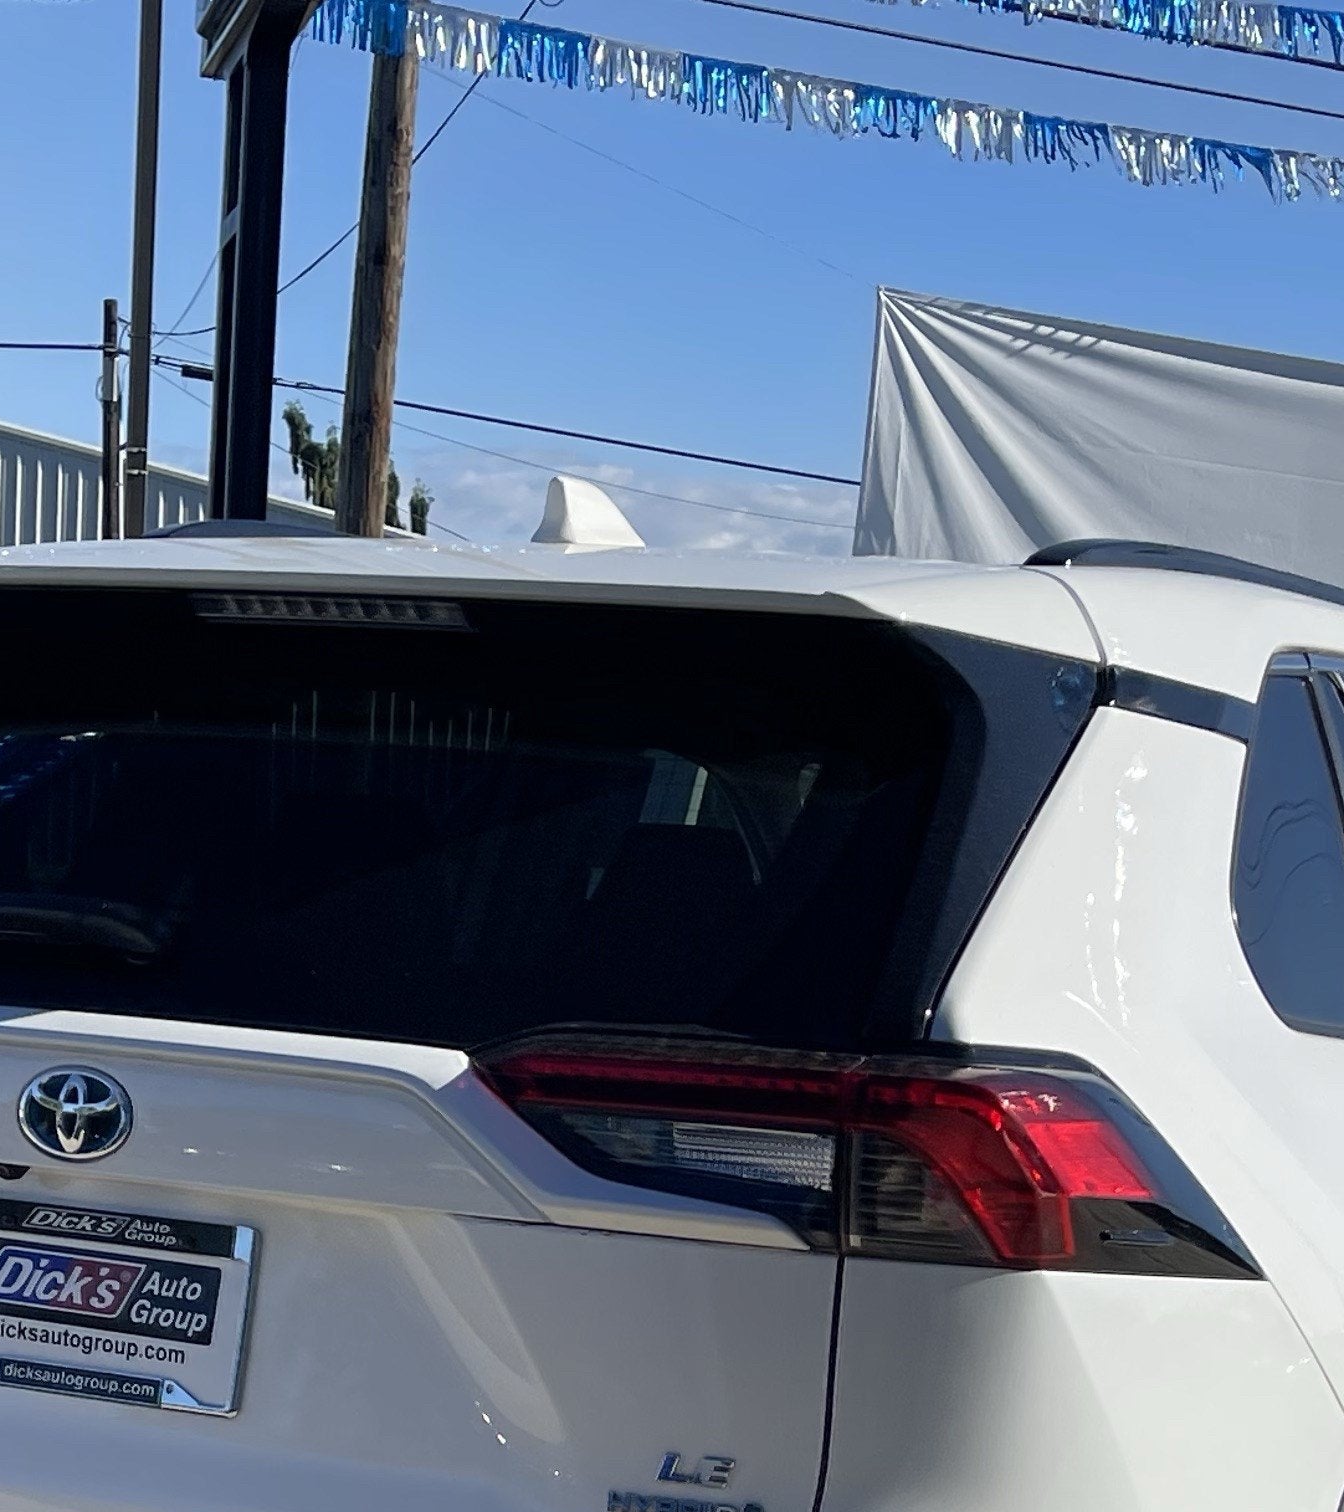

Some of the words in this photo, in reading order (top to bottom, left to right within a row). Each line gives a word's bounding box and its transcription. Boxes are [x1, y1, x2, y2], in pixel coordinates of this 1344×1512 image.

[31, 1208, 115, 1234] Dick's
[130, 1219, 171, 1234] Auto
[124, 1230, 178, 1247] Group
[141, 1271, 202, 1301] Auto
[129, 1299, 207, 1337] Group
[4, 1362, 155, 1397] dicksautogroup.com
[656, 1452, 736, 1489] LE
